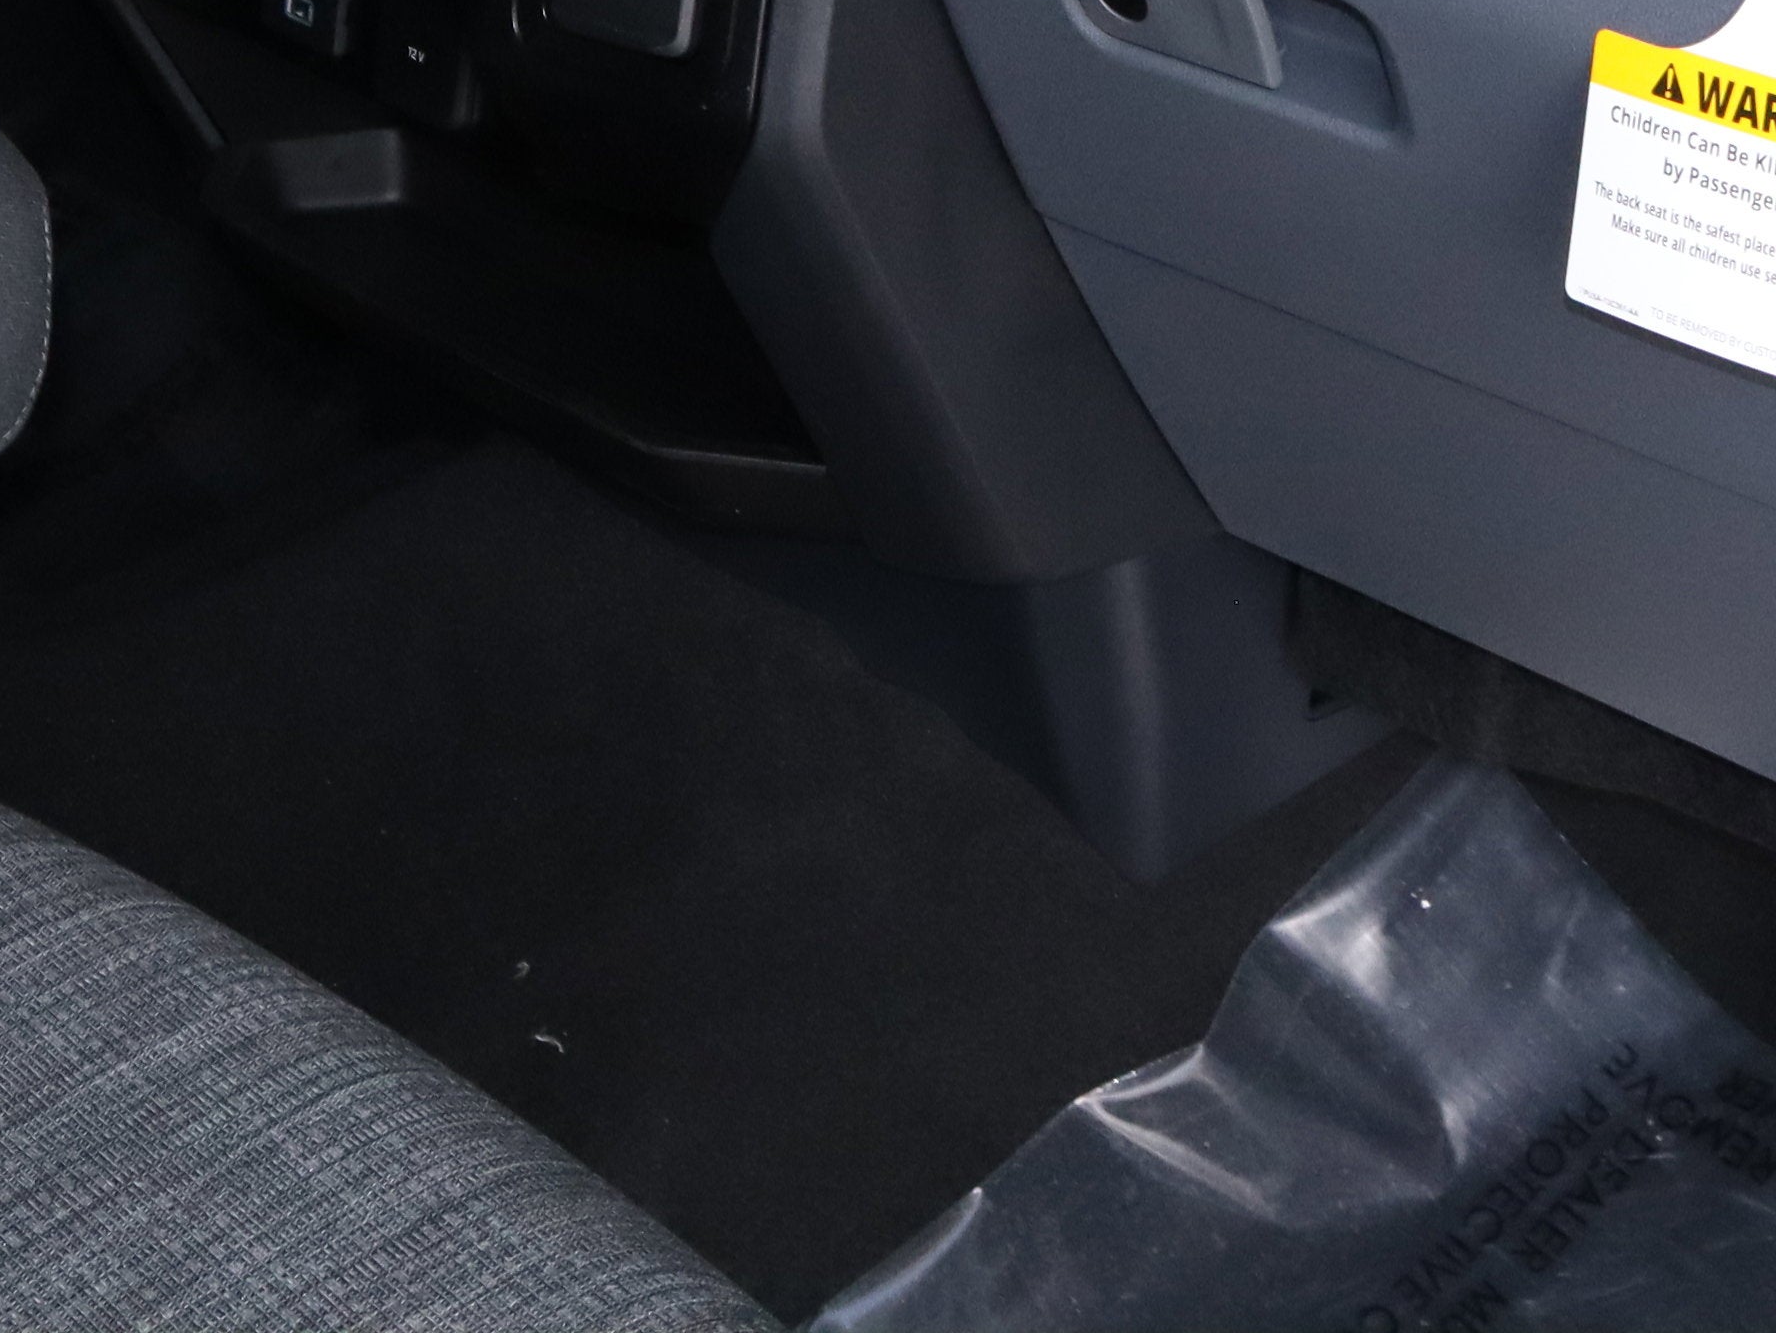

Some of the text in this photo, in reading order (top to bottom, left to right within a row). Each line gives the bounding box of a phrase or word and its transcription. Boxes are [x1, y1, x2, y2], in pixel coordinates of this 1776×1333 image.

[1611, 105, 1681, 144] Children
[1687, 132, 1720, 157] Can
[1727, 144, 1749, 166] Be
[1663, 157, 1684, 184] by
[1593, 180, 1613, 201] The
[1615, 189, 1640, 211] back
[1644, 202, 1667, 221] seat
[1669, 209, 1679, 224] is
[1682, 215, 1702, 233] the
[1705, 223, 1740, 247] safest
[1743, 235, 1776, 258] place
[1610, 213, 1641, 237] Make
[1644, 228, 1668, 247] sure
[1670, 238, 1686, 254] all
[1688, 243, 1737, 271] children
[1740, 263, 1761, 280] use
[1650, 306, 1664, 320] TO
[1665, 313, 1678, 327] BE
[1678, 319, 1727, 343] REMOVED
[1728, 335, 1742, 347] BY
[1393, 1085, 1610, 1308] PROTECTIVE
[1511, 1127, 1657, 1271] DEALER
